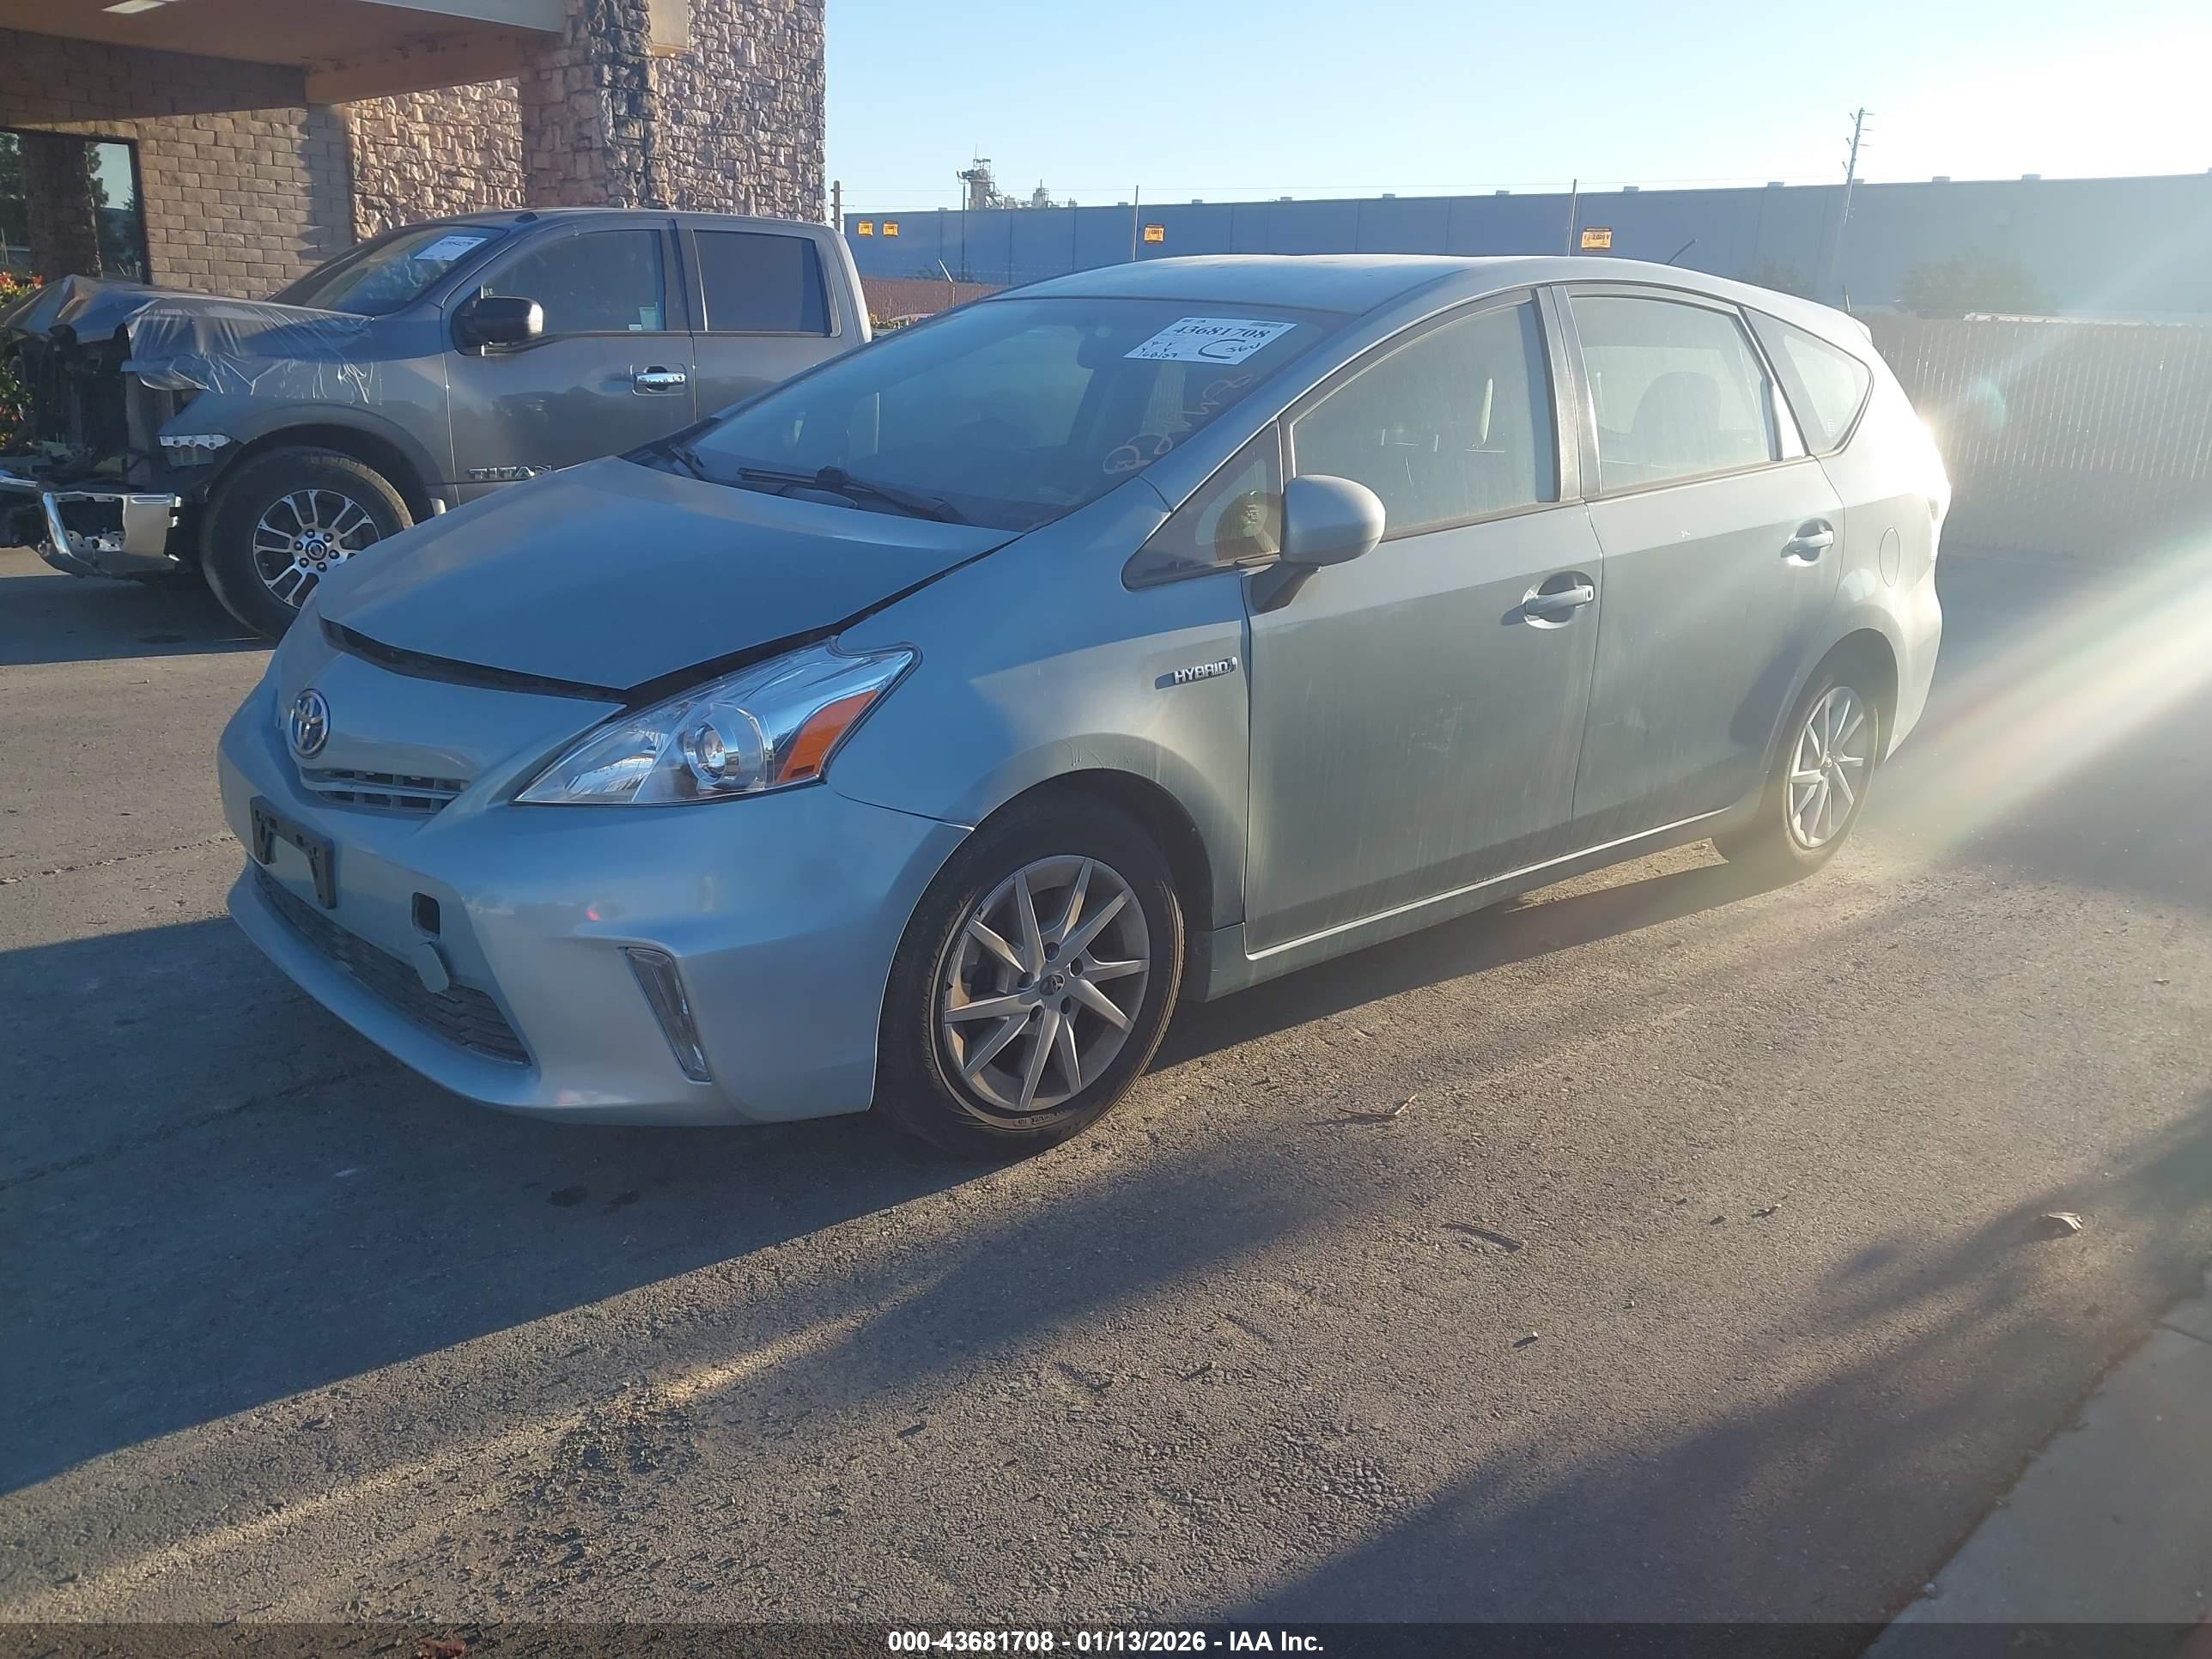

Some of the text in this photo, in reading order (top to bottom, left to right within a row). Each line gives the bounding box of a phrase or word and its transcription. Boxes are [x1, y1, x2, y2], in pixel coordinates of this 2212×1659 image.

[1172, 325, 1272, 338] 43681708
[469, 465, 552, 479] TITAN
[1174, 660, 1229, 684] HYBRID
